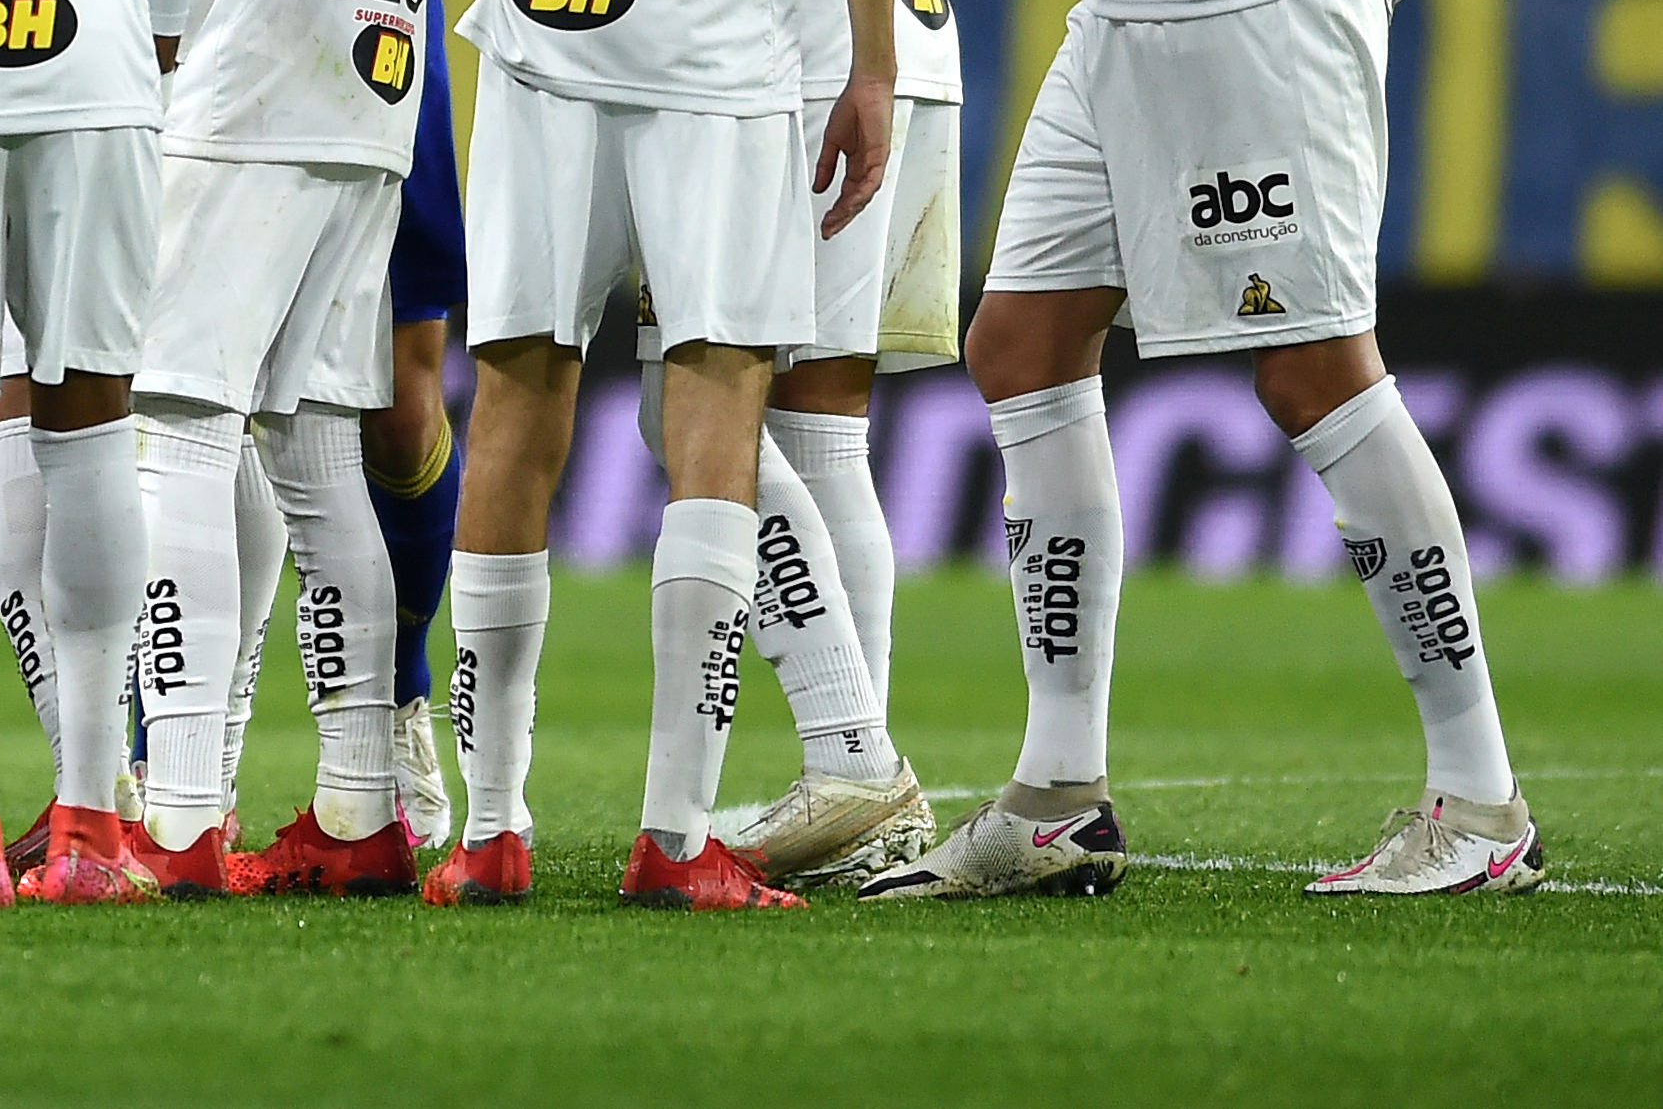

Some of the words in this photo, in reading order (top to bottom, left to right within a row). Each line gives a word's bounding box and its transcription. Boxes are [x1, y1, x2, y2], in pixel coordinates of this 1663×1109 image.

[371, 32, 410, 91] BH
[1189, 171, 1295, 229] abc
[1194, 233, 1213, 247] da
[1214, 222, 1299, 245] construção
[758, 514, 827, 629] TODOS
[1022, 554, 1043, 574] de
[1389, 571, 1414, 593] de
[298, 606, 312, 622] de
[708, 621, 730, 642] de
[1022, 584, 1043, 649] Cartão
[1043, 537, 1085, 664] TODOS
[1400, 600, 1444, 663] Cartão
[1410, 546, 1475, 671] TODOS
[146, 578, 187, 697] TODOS
[311, 586, 347, 699] TODOS
[716, 609, 750, 731] TODOS
[458, 647, 478, 754] TODOS
[697, 651, 723, 716] Cartão
